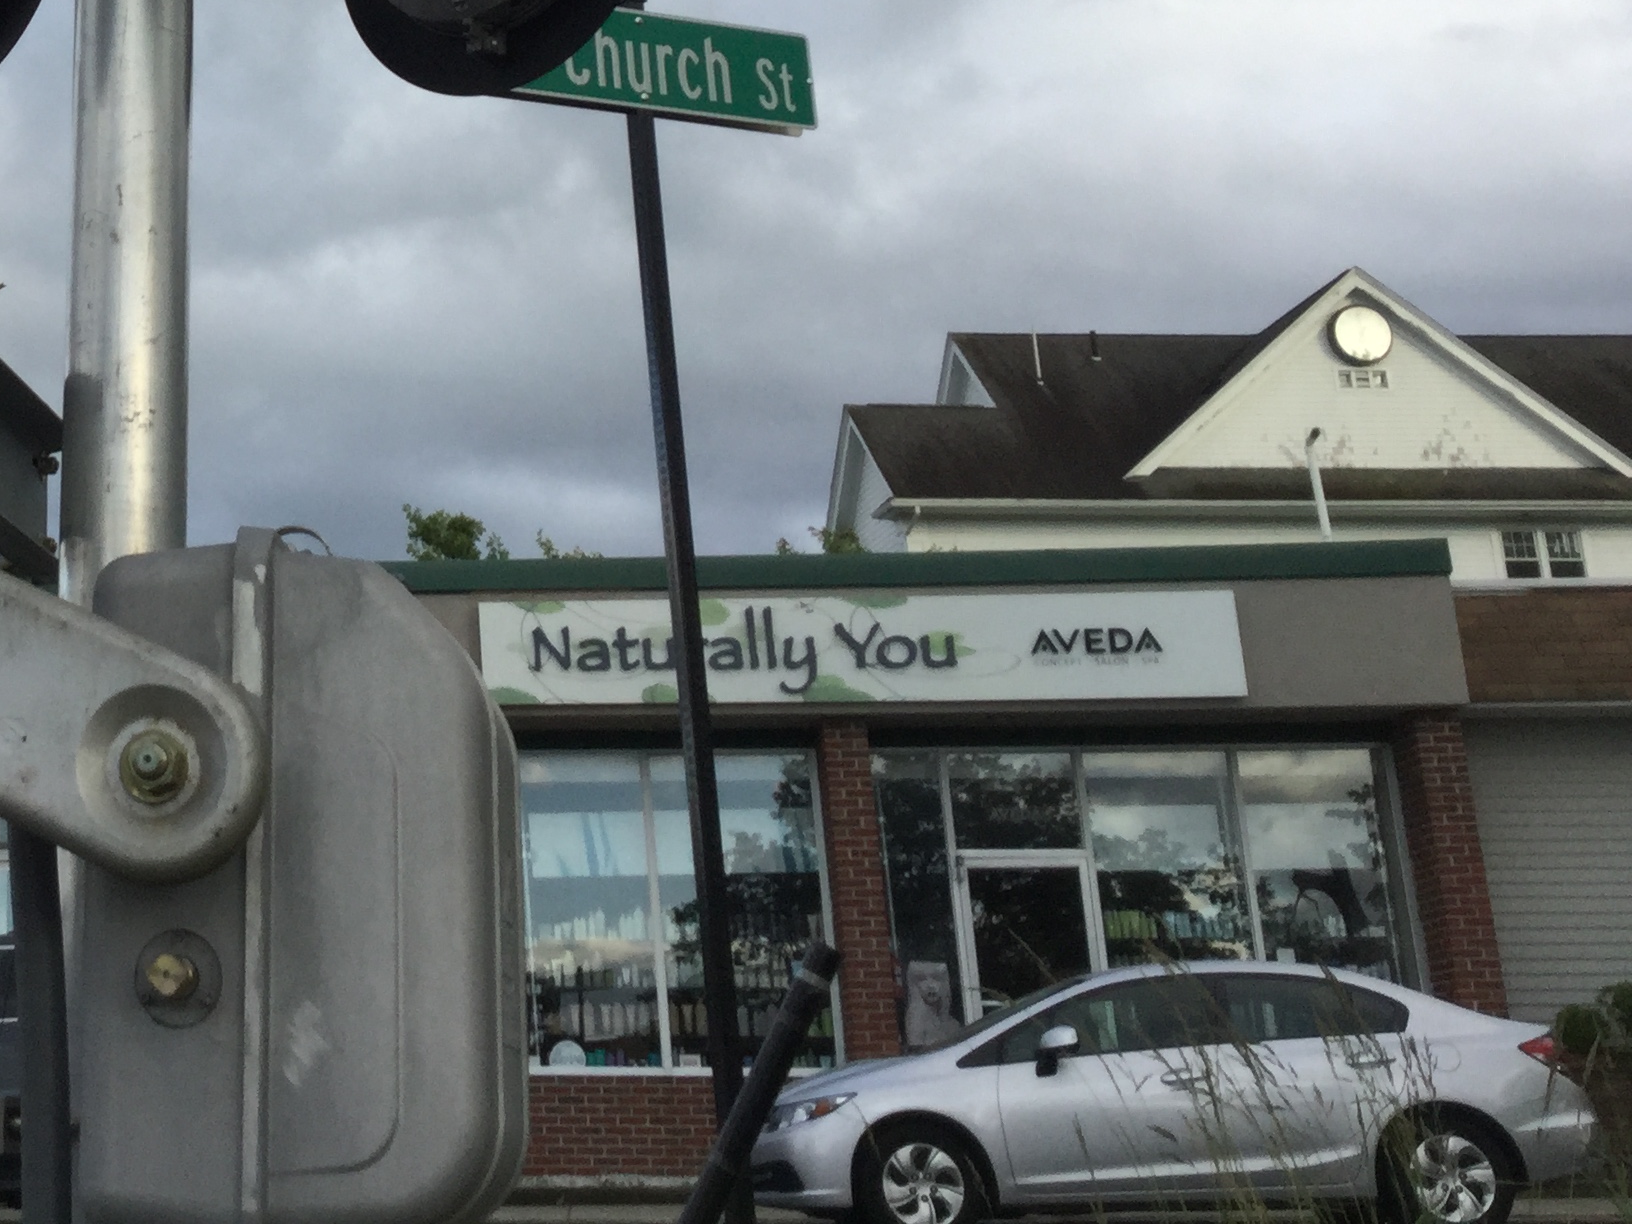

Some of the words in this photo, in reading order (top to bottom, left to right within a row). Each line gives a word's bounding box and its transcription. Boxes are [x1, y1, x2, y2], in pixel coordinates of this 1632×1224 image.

[755, 57, 796, 112] St
[531, 605, 817, 694] Natually
[833, 622, 958, 669] You
[1031, 627, 1163, 656] AVEDA
